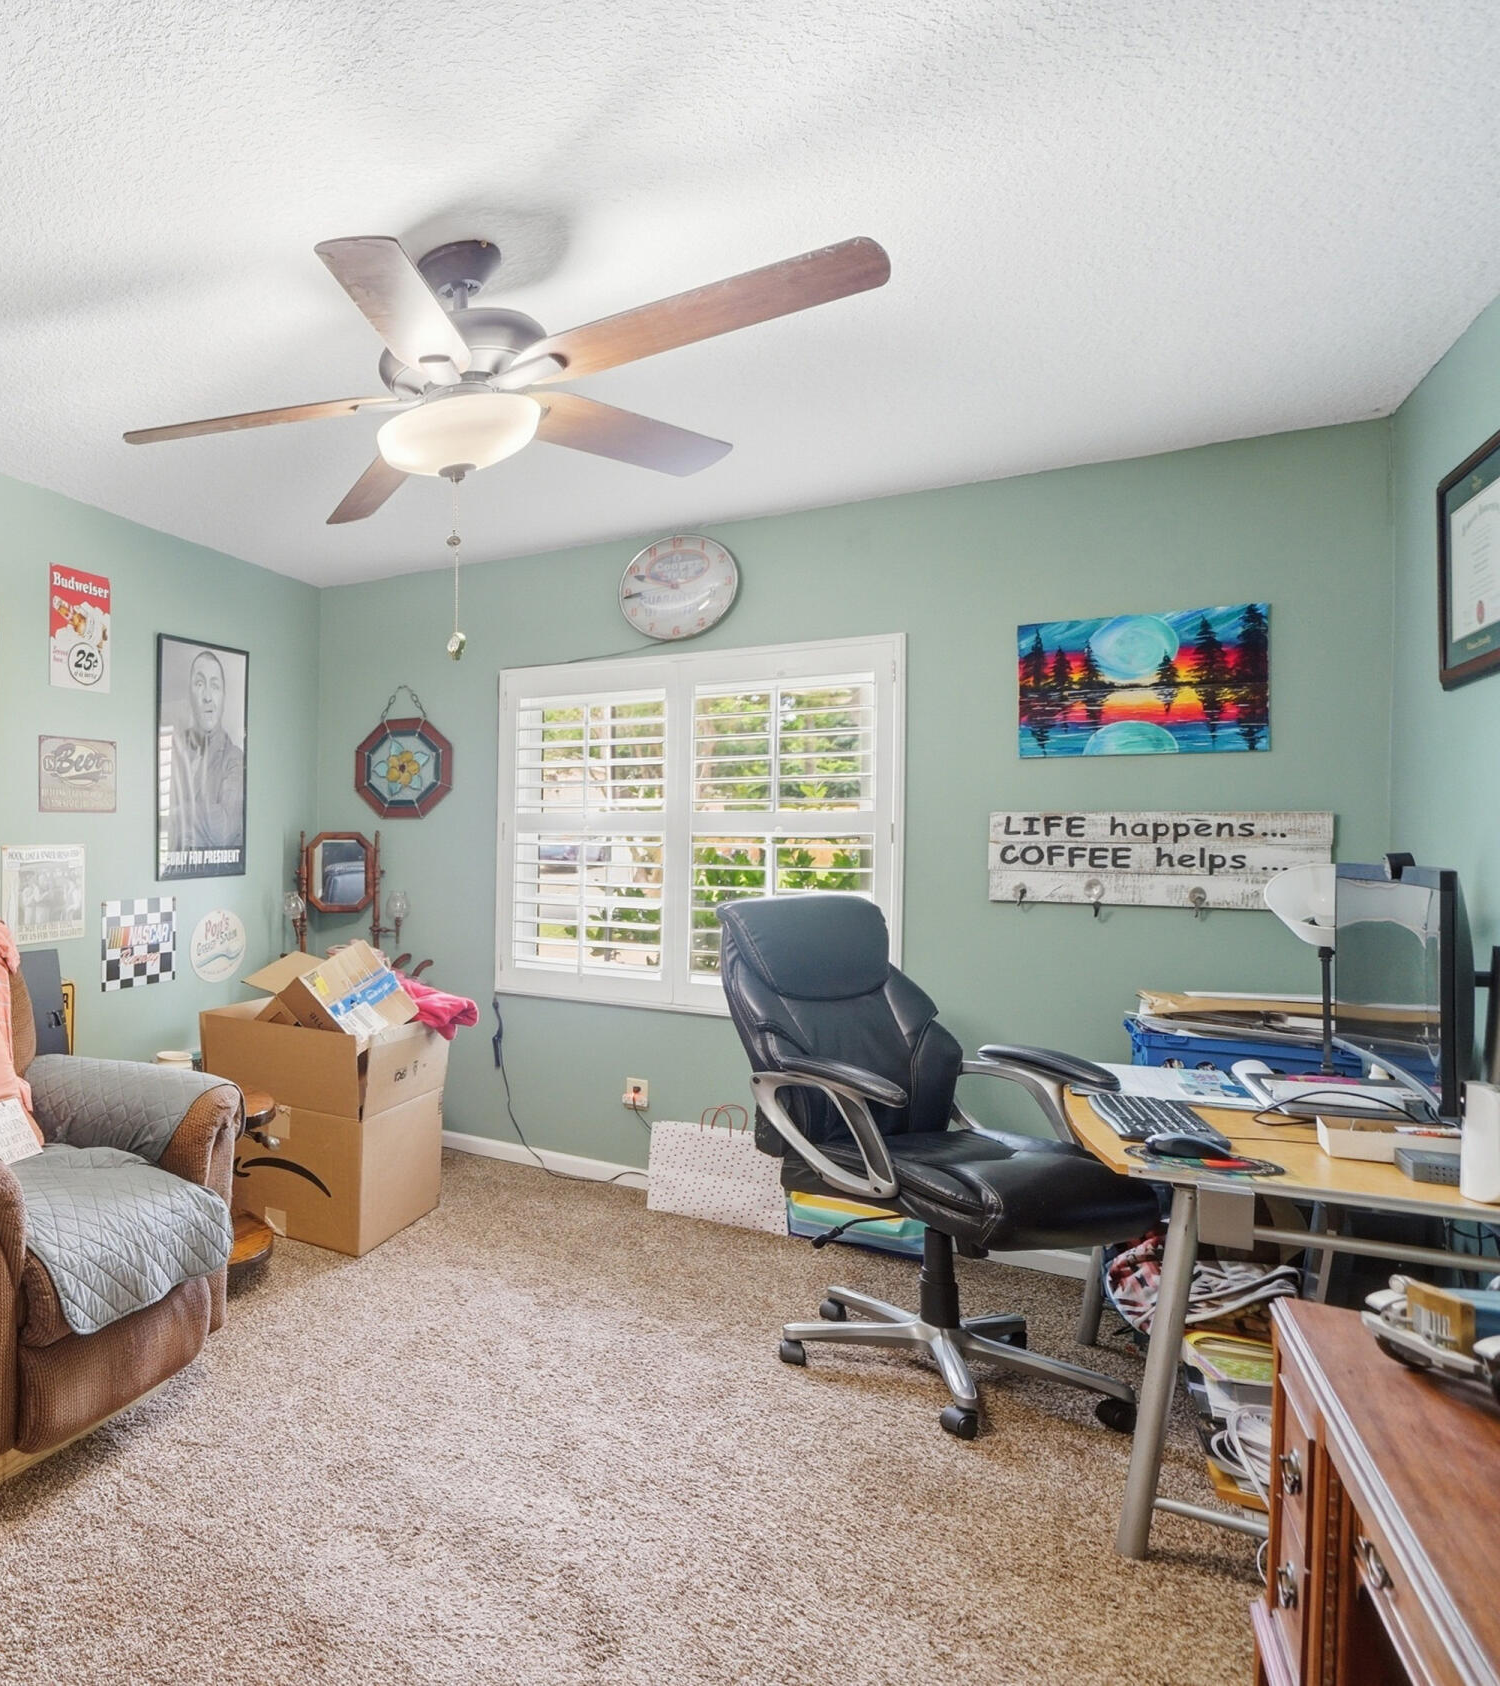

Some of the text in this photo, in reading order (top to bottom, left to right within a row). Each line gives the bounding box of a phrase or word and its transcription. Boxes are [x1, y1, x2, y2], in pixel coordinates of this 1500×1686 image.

[53, 571, 109, 599] Budweiser
[53, 742, 106, 774] Beer
[1003, 815, 1289, 844] LIFE happens...
[166, 848, 241, 867] CURLY FOR PRESIDENT
[1000, 844, 1132, 869] COFFEE
[1155, 846, 1248, 875] helps
[129, 923, 172, 947] NASCAR
